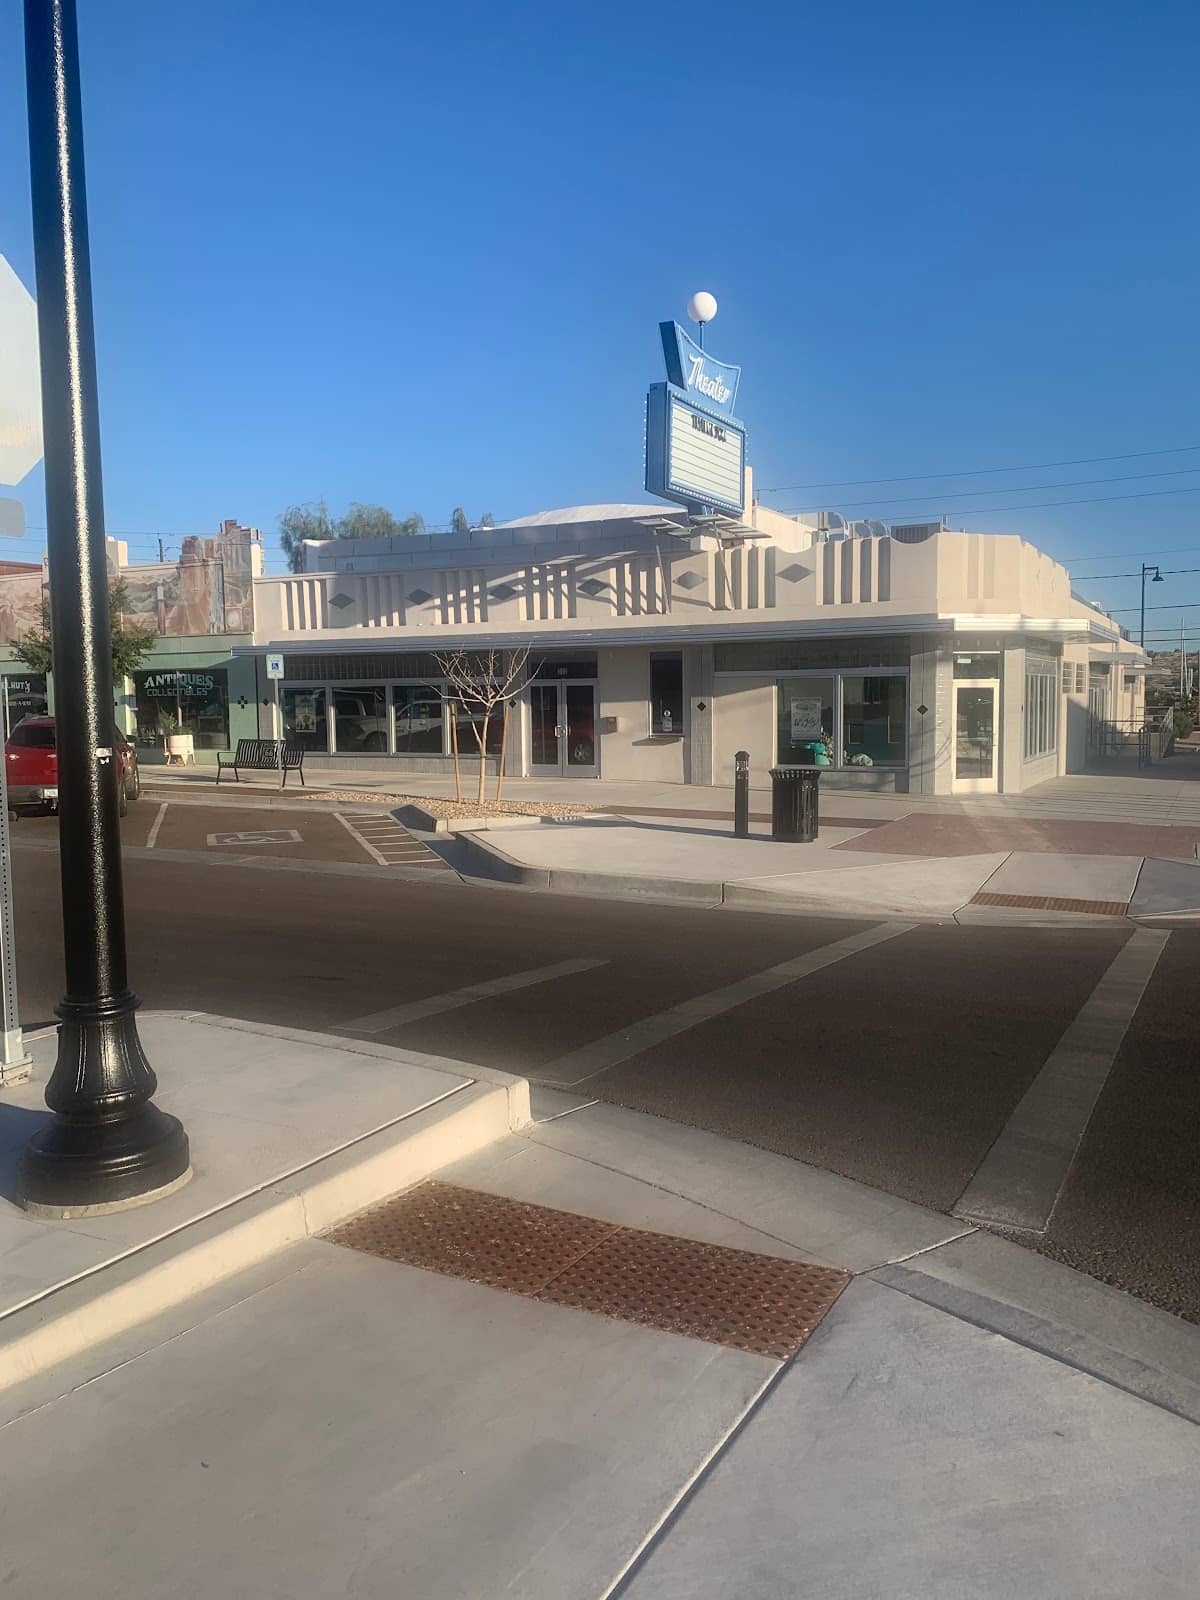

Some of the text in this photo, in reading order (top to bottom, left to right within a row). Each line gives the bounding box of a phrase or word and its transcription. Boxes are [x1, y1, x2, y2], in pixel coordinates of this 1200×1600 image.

[688, 353, 730, 403] Theater
[143, 673, 214, 690] ANTIQUES
[146, 687, 208, 697] COLLECTIBLES
